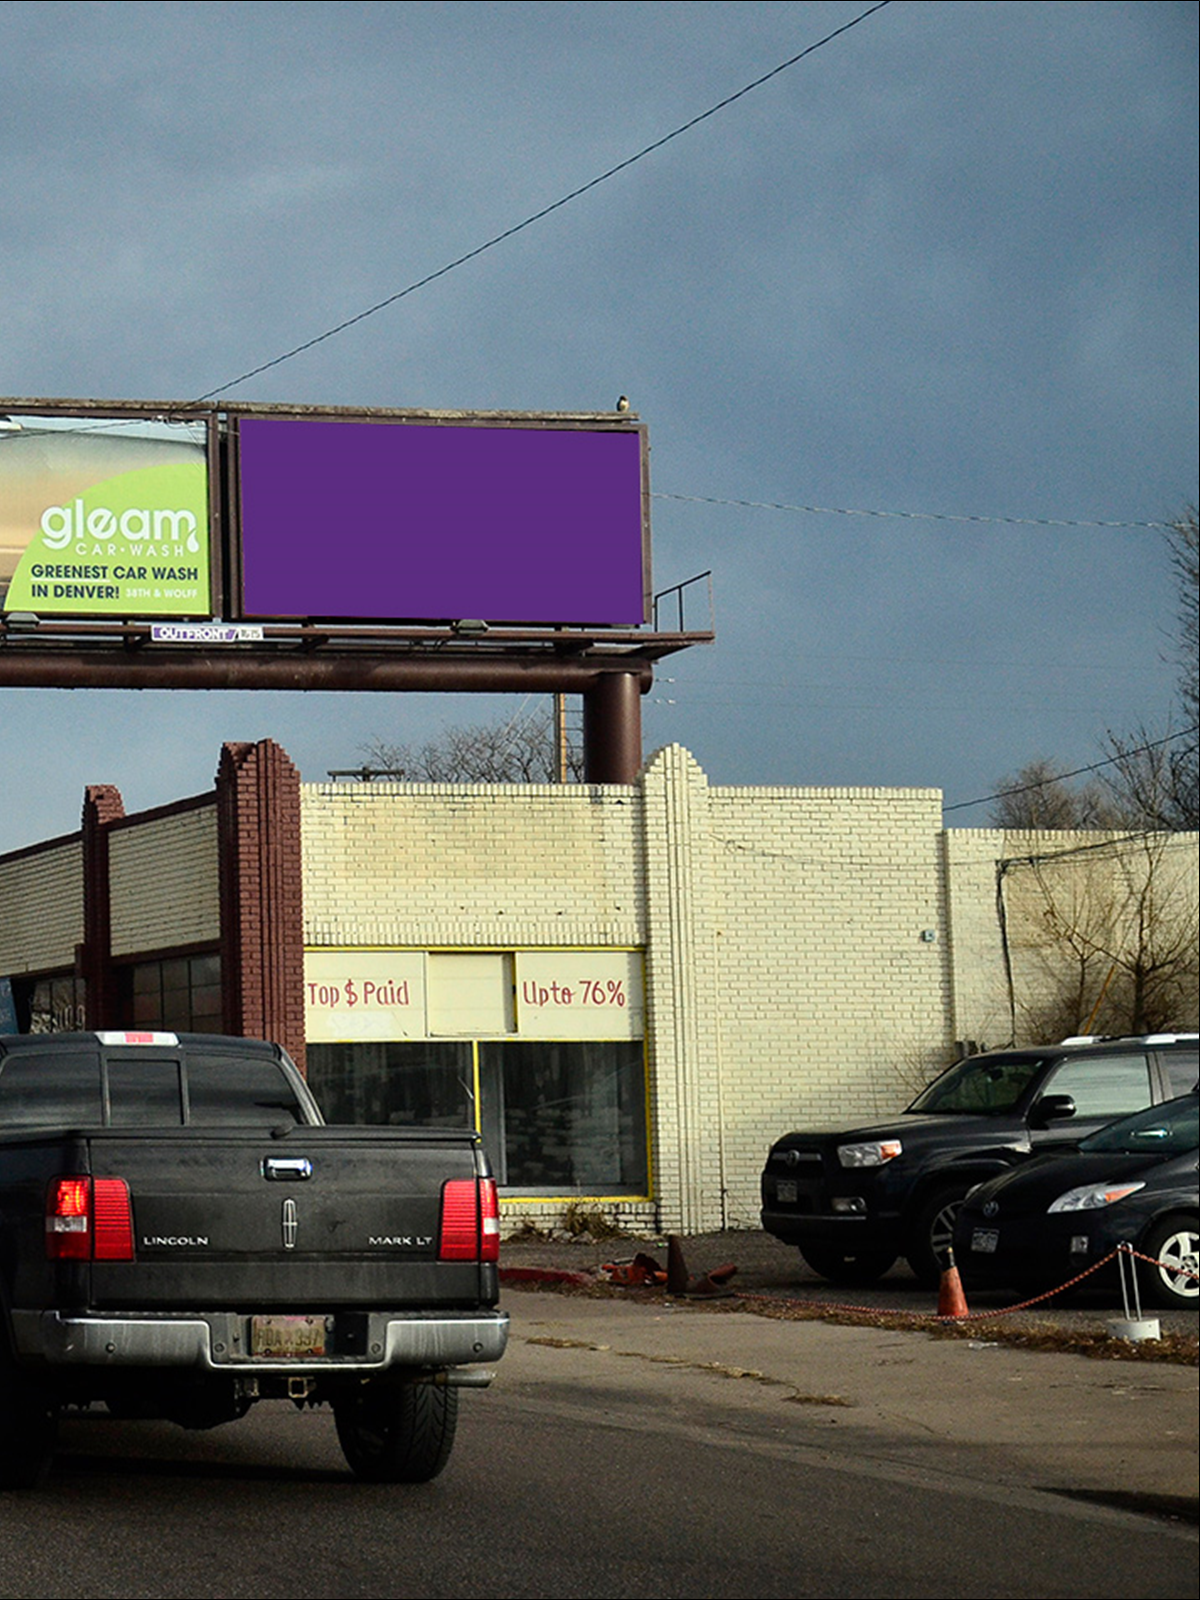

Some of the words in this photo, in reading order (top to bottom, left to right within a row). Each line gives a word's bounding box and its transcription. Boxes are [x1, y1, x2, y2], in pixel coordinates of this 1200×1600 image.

[40, 498, 200, 552] gleam
[129, 544, 184, 557] WASH
[31, 564, 108, 580] GREENEST
[113, 565, 147, 580] CAR
[152, 567, 198, 581] WASH
[31, 584, 48, 598] IN
[53, 585, 119, 599] DENVER!
[154, 589, 161, 598] &
[164, 589, 198, 599] WOLFF
[307, 983, 340, 1008] Top
[364, 980, 409, 1006] Paid
[579, 981, 626, 1007] 76%
[143, 1236, 209, 1246] LINCOLN
[369, 1236, 412, 1246] MARK
[416, 1236, 432, 1246] LT
